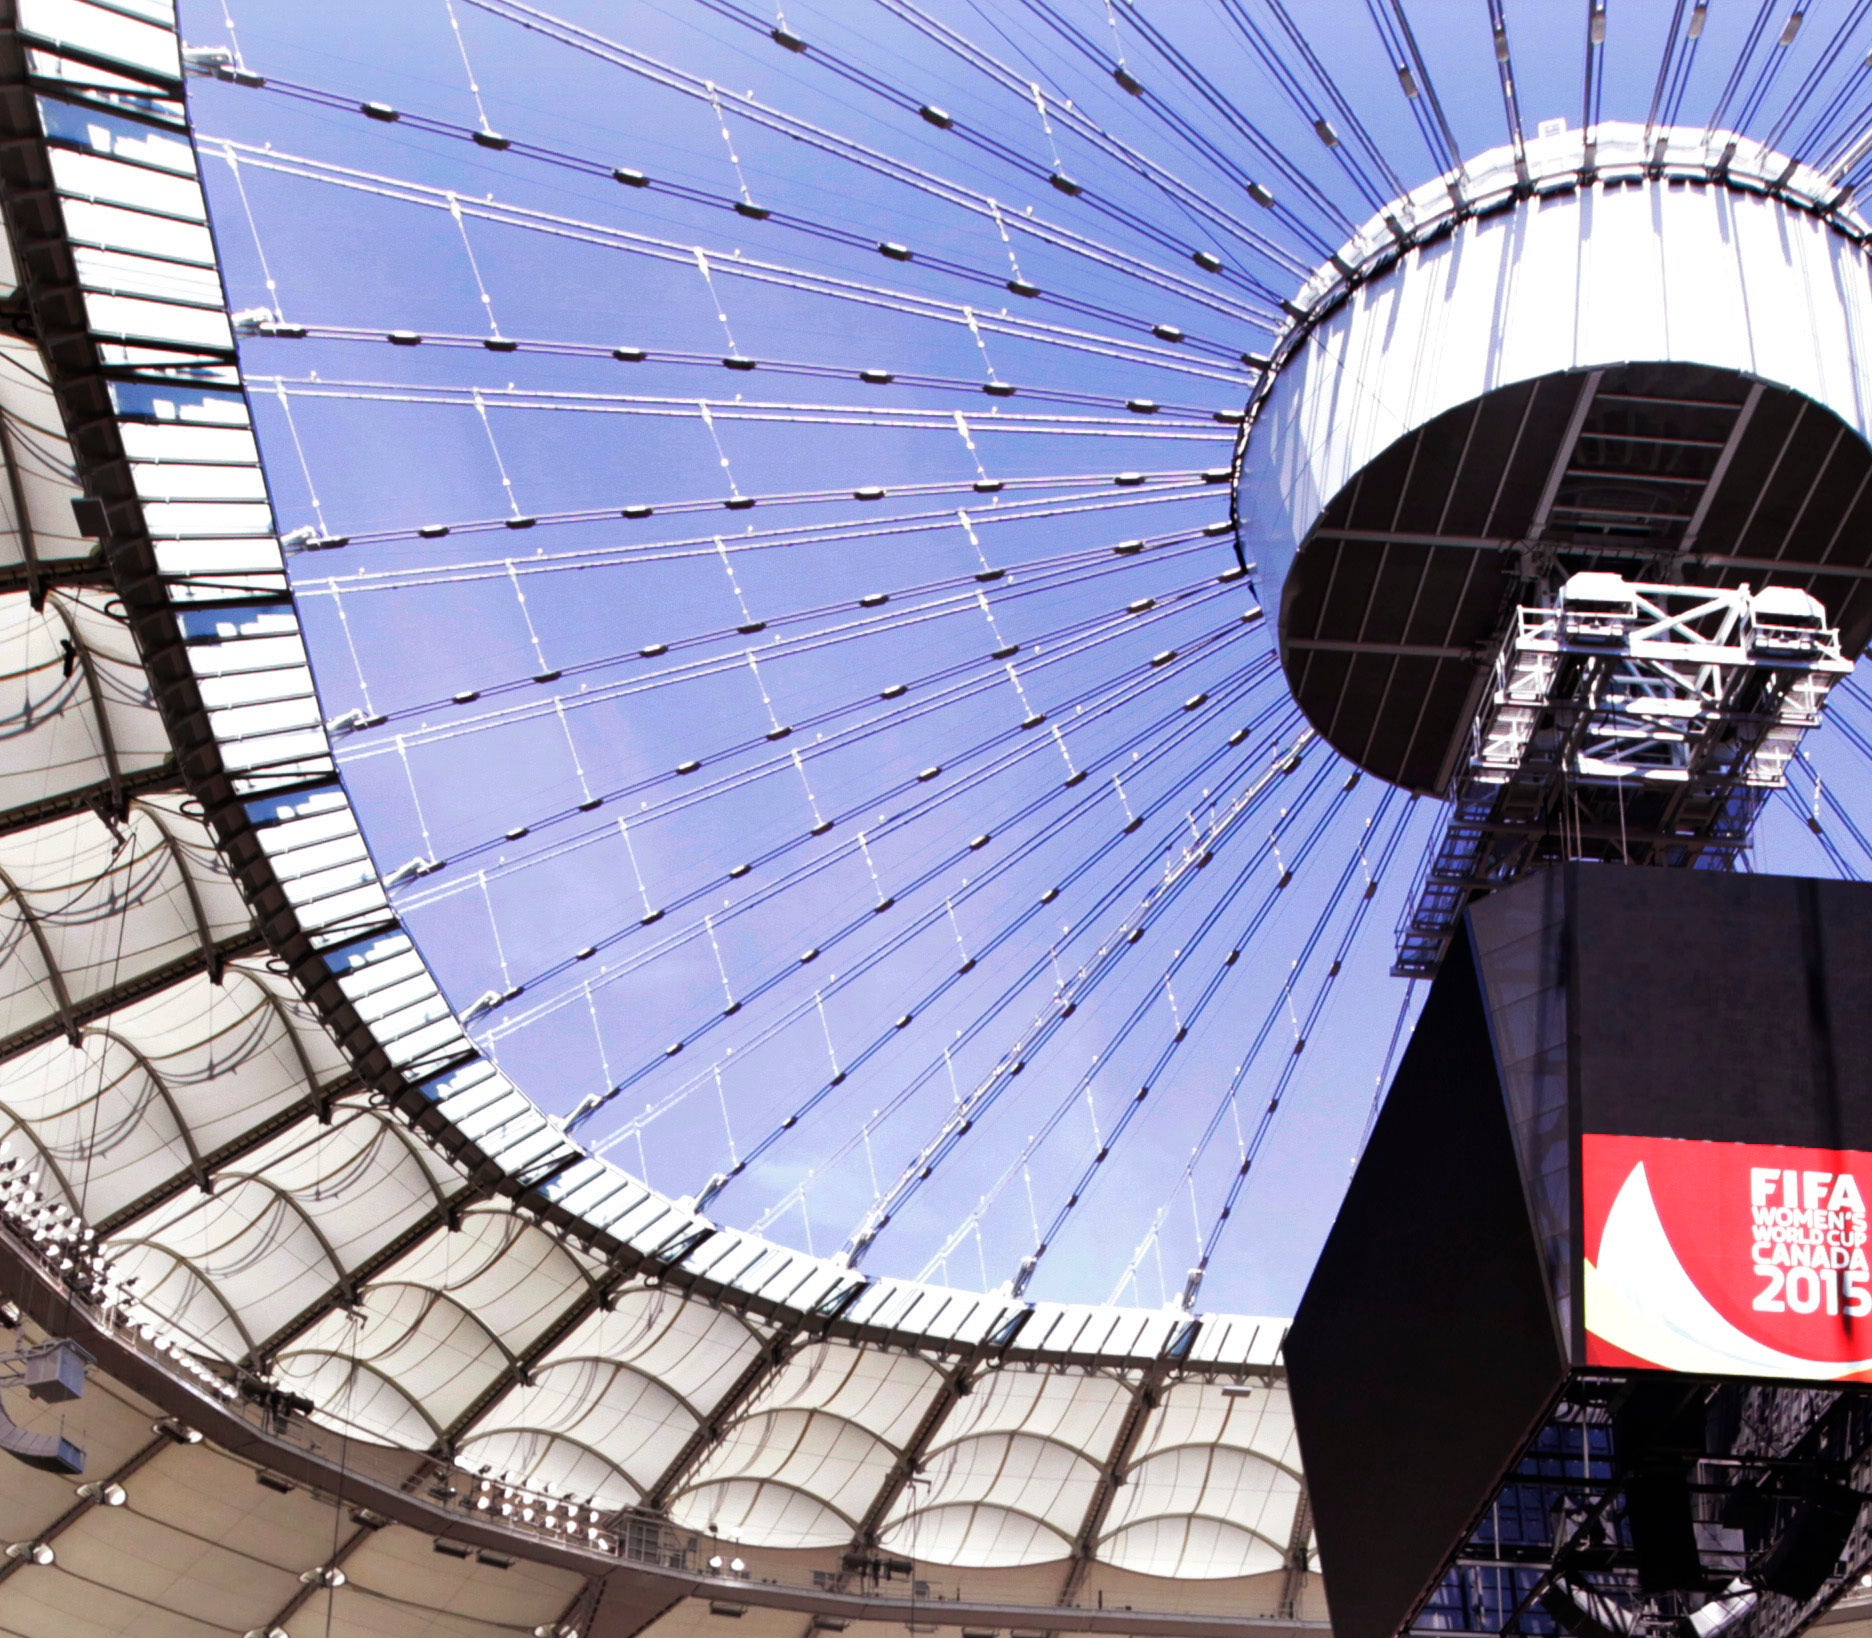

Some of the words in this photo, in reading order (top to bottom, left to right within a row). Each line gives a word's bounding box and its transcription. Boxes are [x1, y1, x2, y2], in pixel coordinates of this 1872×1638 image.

[1750, 1167, 1866, 1213] FIFA
[1751, 1206, 1868, 1232] WOMEN'S
[1751, 1224, 1825, 1246] WORLD
[1826, 1230, 1868, 1248] CUP
[1751, 1241, 1870, 1272] CANADA
